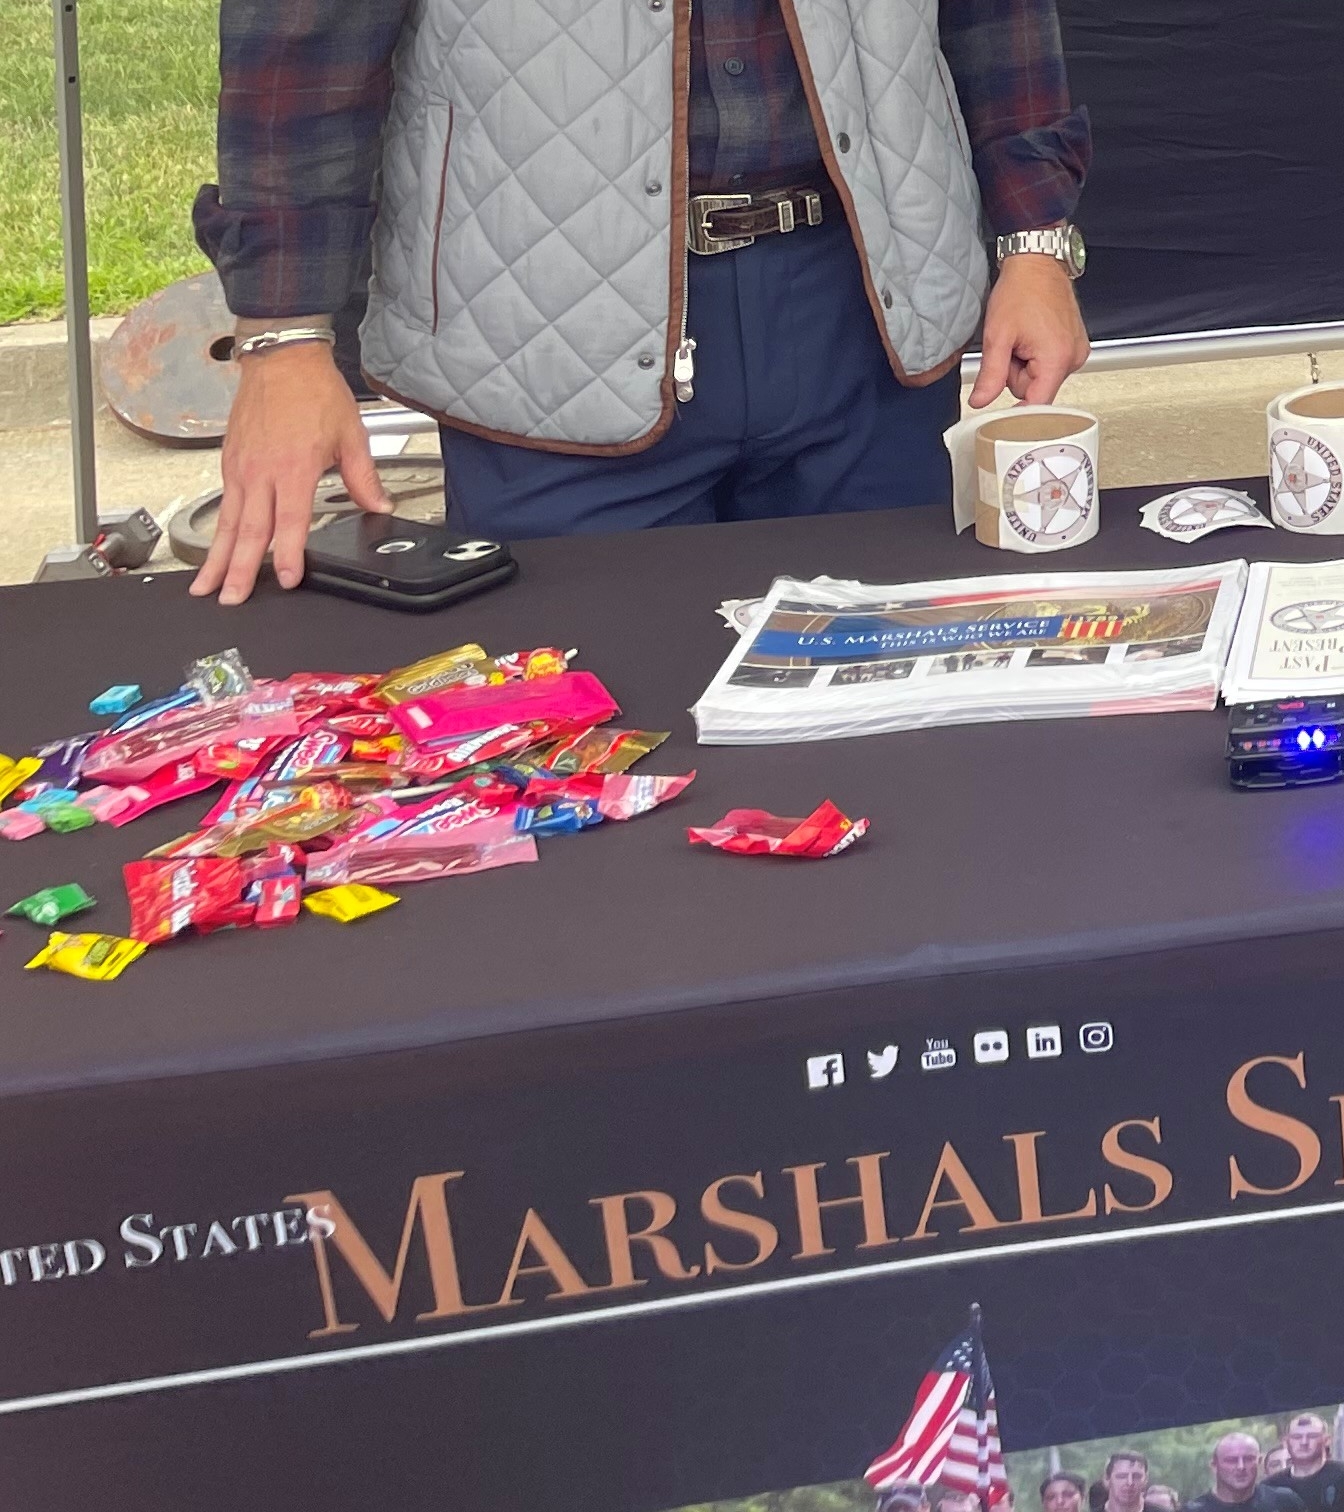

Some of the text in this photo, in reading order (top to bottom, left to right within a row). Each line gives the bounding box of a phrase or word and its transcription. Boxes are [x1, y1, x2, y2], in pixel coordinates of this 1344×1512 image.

[1306, 436, 1342, 524] UNITED STATES
[1005, 453, 1037, 542] UNITE ATES
[797, 619, 1050, 646] U.S. MARSHALS SERVICE
[1279, 655, 1329, 672] PAST
[926, 1037, 949, 1050] You
[925, 1051, 954, 1067] Tube
[0, 1238, 106, 1286] TED
[120, 1204, 336, 1268] STATES
[283, 1116, 1174, 1340] MARSHALS
